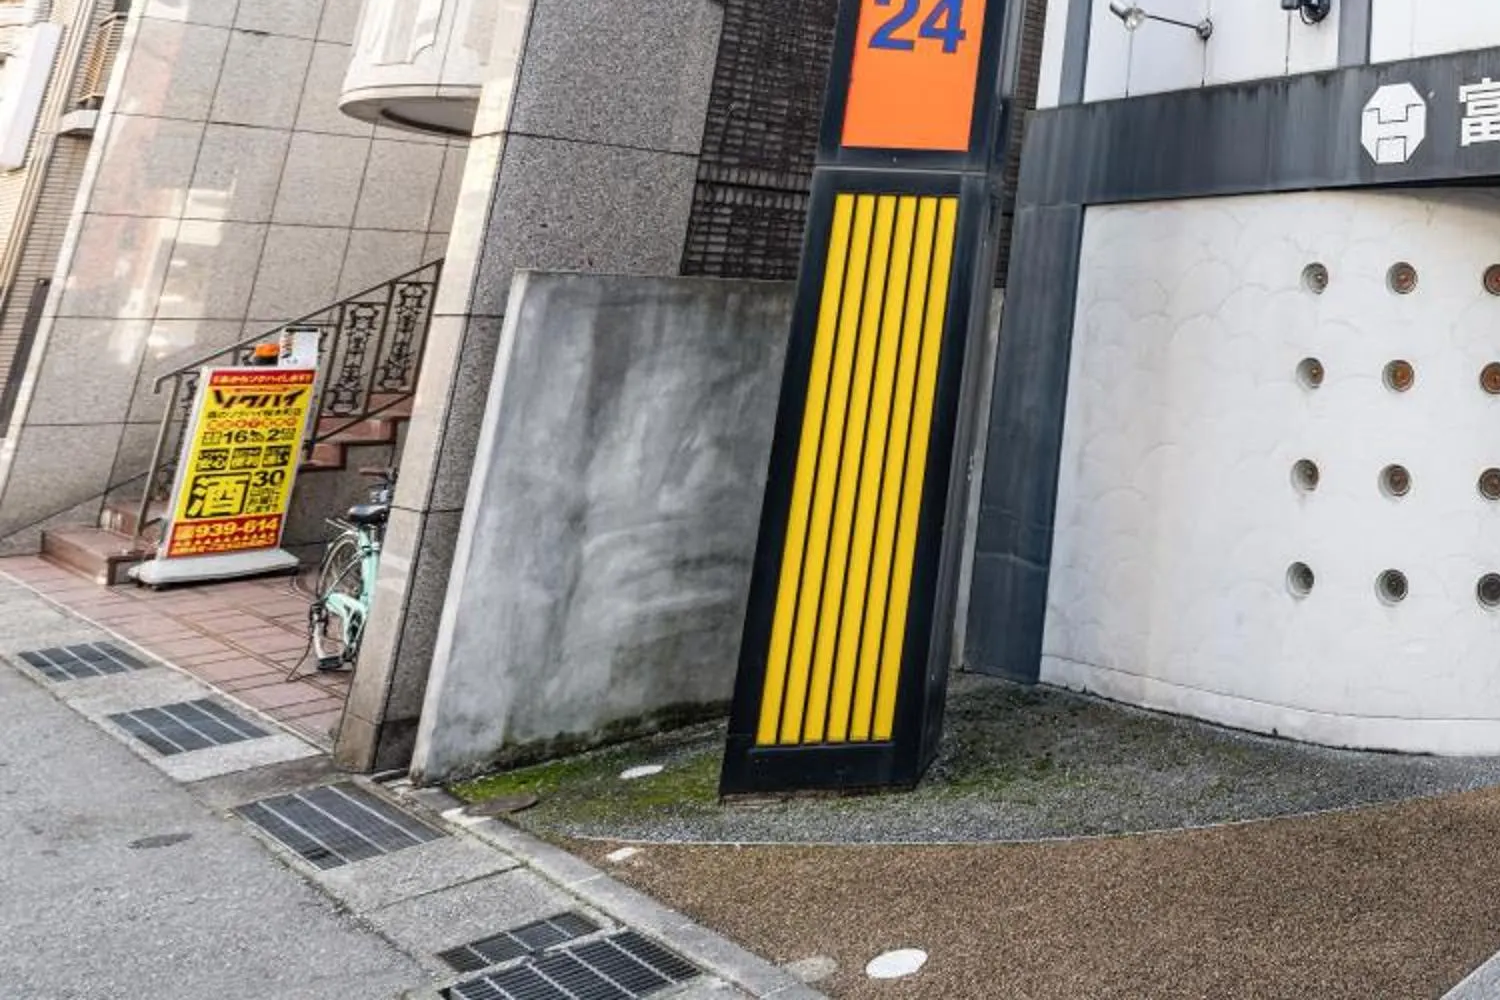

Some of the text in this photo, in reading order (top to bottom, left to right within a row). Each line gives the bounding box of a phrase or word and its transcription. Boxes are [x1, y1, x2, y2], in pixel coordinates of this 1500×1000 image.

[223, 429, 248, 444] 16
[252, 469, 285, 488] 30
[188, 475, 249, 517] 酒
